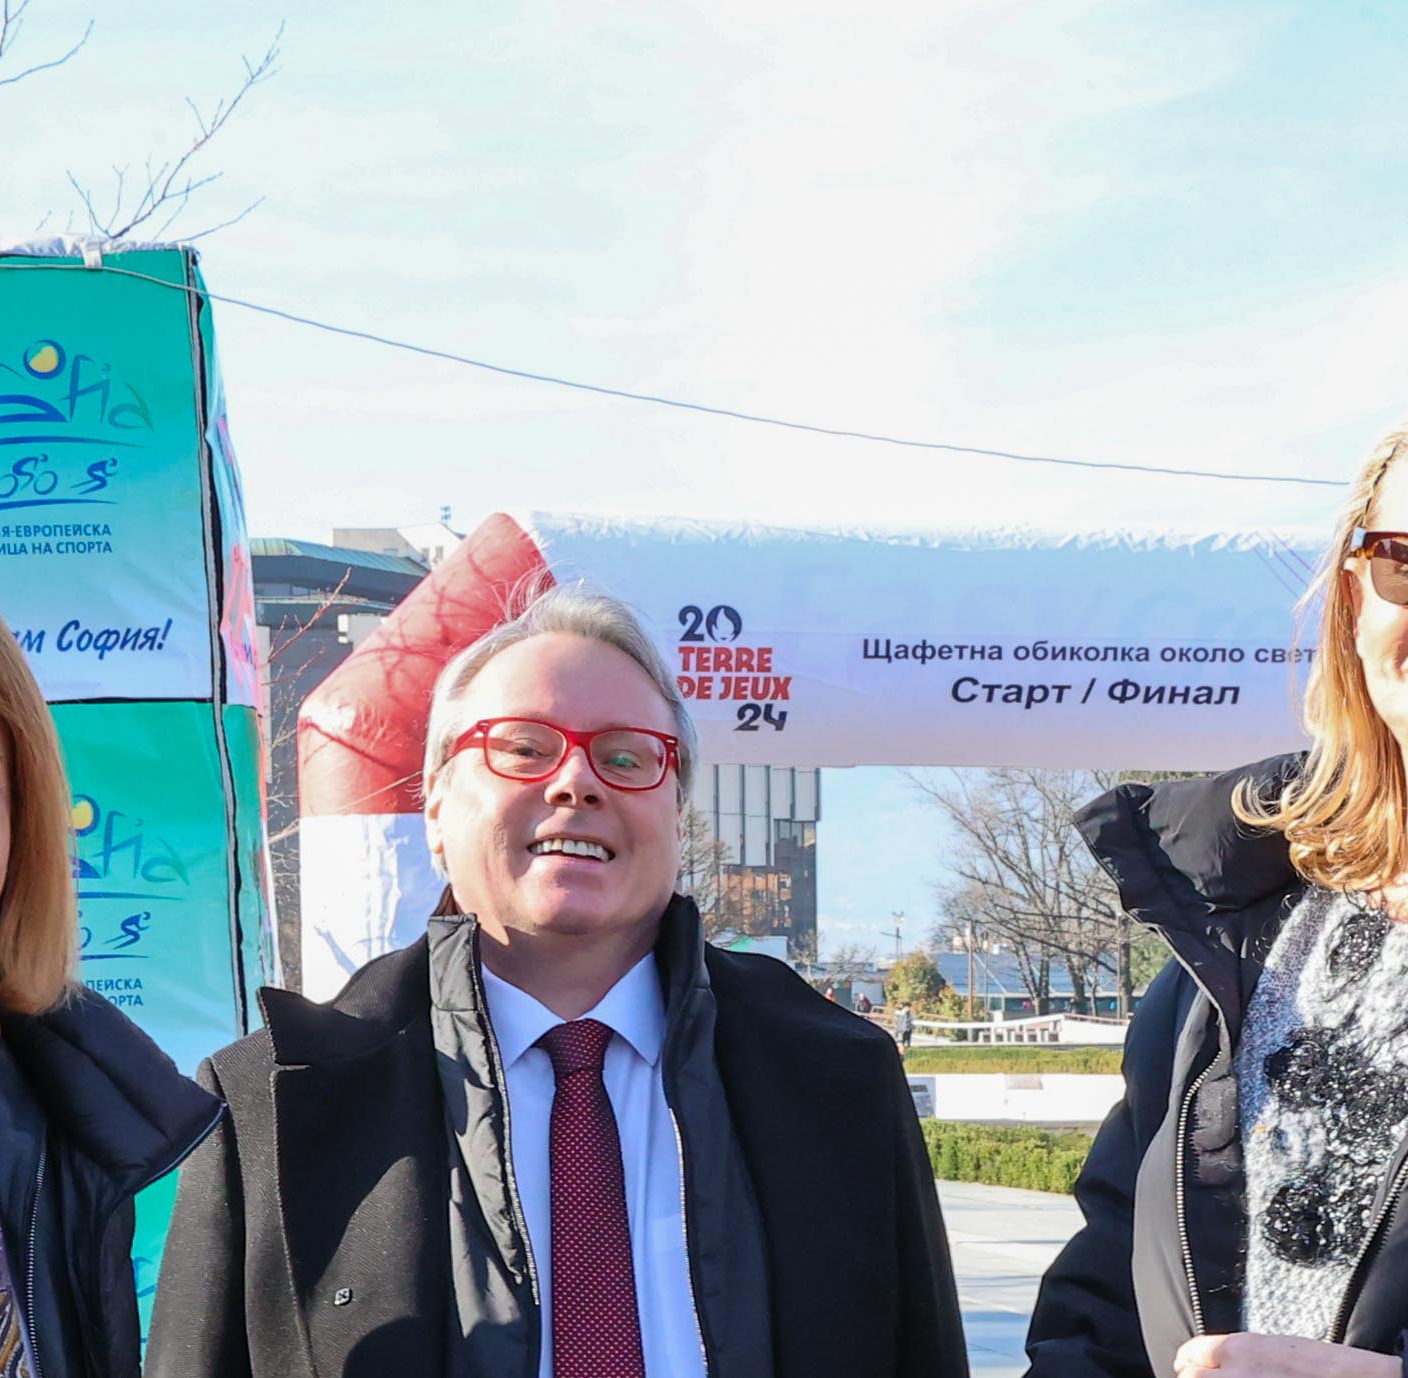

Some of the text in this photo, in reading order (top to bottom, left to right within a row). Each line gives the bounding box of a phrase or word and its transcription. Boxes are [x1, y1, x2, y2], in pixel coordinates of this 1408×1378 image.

[32, 541, 53, 555] НА
[56, 541, 113, 554] СПОРТА
[678, 604, 743, 643] 20
[56, 618, 173, 660] София!
[863, 638, 1316, 664] Щафетна обиколка около свет
[678, 646, 773, 673] TERRE
[676, 675, 793, 701] DE JEUX
[951, 676, 1241, 710] Старт / Финал
[733, 703, 788, 732] 24
